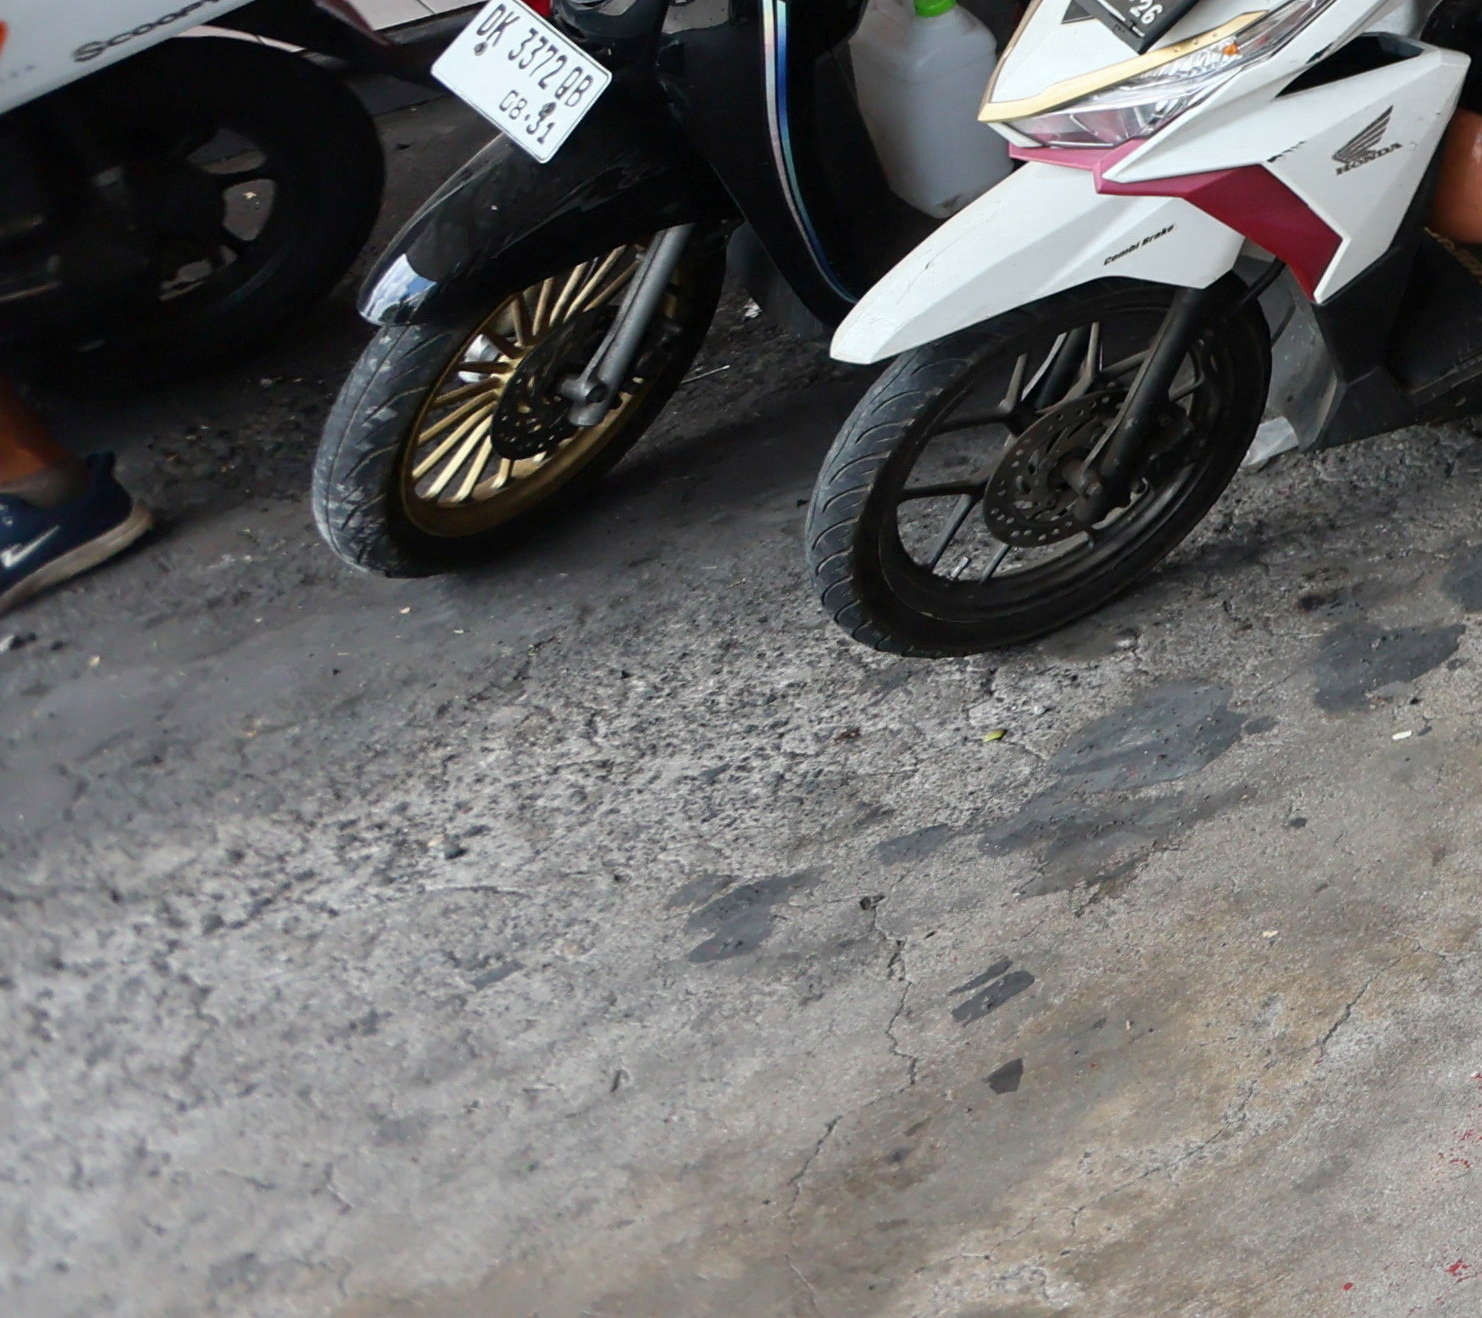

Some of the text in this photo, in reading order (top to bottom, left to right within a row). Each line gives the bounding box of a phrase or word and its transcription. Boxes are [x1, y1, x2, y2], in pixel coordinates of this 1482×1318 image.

[476, 3, 521, 48] DK
[508, 25, 569, 93] 3372
[1336, 142, 1402, 177] HONDA
[1104, 223, 1175, 266] Combi Brake
